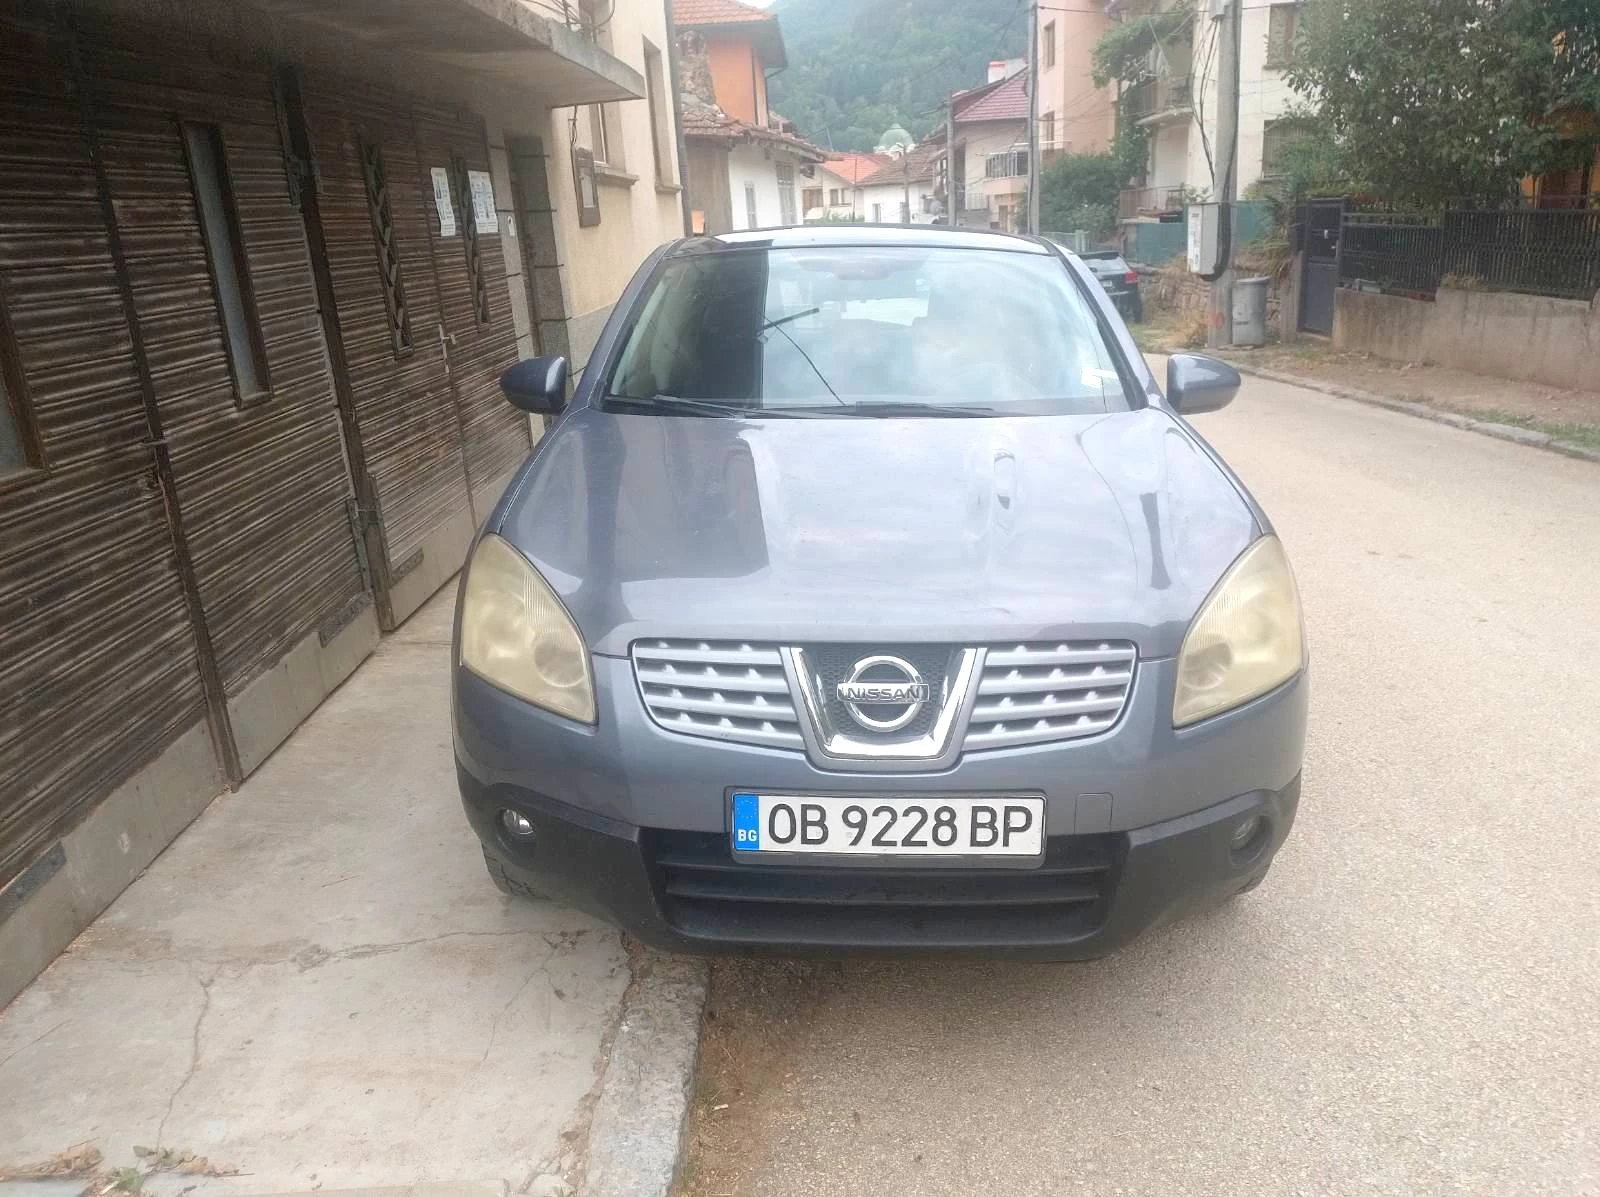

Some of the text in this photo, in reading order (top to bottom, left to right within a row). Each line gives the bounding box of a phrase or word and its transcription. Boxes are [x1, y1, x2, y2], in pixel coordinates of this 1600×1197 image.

[847, 686, 920, 700] NISSAN
[768, 803, 1033, 848] OB 9228 BP
[737, 829, 757, 842] BG
